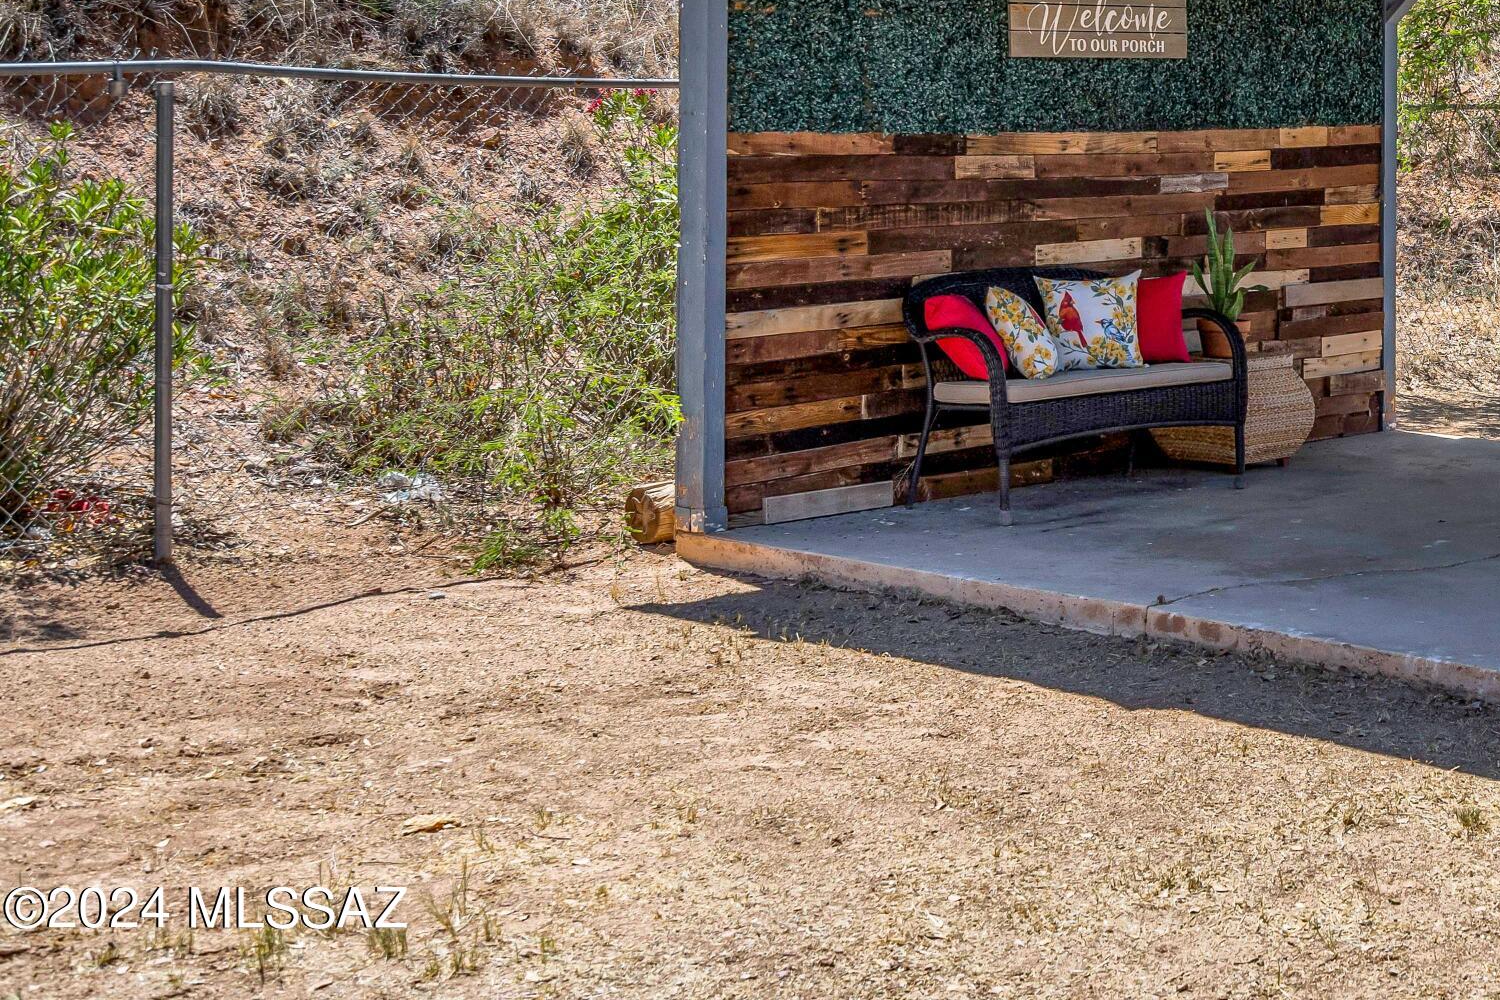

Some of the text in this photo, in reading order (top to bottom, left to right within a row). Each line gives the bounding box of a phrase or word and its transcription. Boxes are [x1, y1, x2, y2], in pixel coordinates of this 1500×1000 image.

[1068, 38, 1165, 53] TO OUR PORCH
